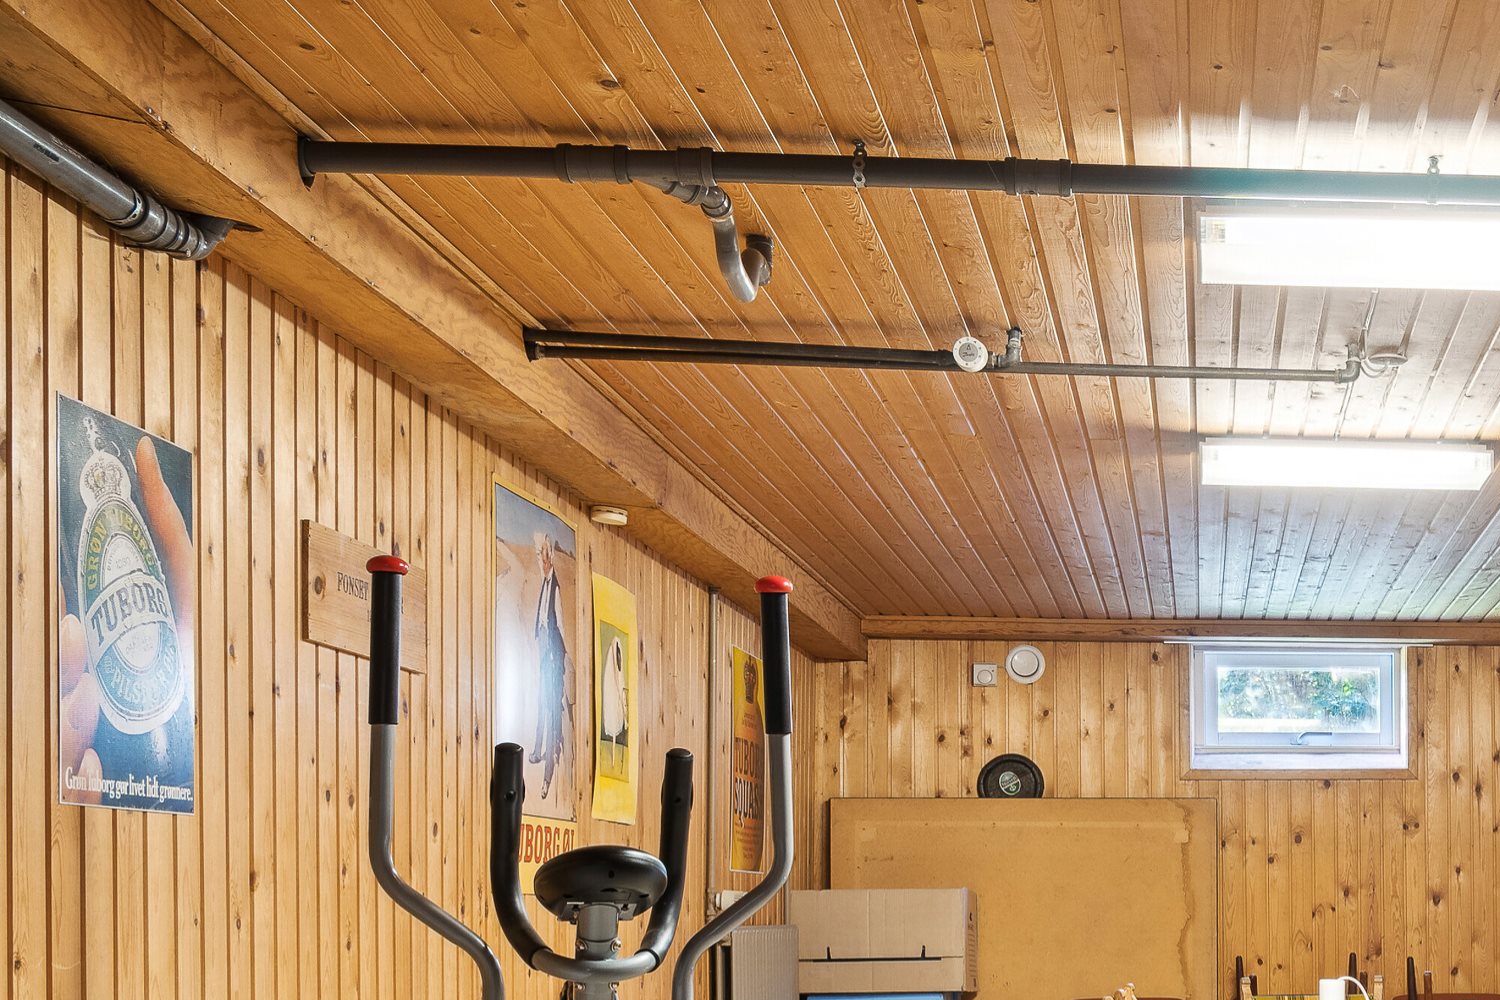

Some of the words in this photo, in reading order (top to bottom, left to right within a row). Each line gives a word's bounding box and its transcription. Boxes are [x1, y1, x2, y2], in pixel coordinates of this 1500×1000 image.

[87, 521, 107, 591] GRØN
[108, 511, 156, 566] TUBORG
[92, 582, 169, 646] TUBORG
[65, 766, 88, 791] Grøn
[88, 770, 116, 799] Tuborg
[116, 779, 129, 800] gør
[129, 773, 145, 797] livet
[146, 774, 160, 798] lidt
[159, 784, 194, 803] grønnere.
[519, 823, 560, 864] UBORG
